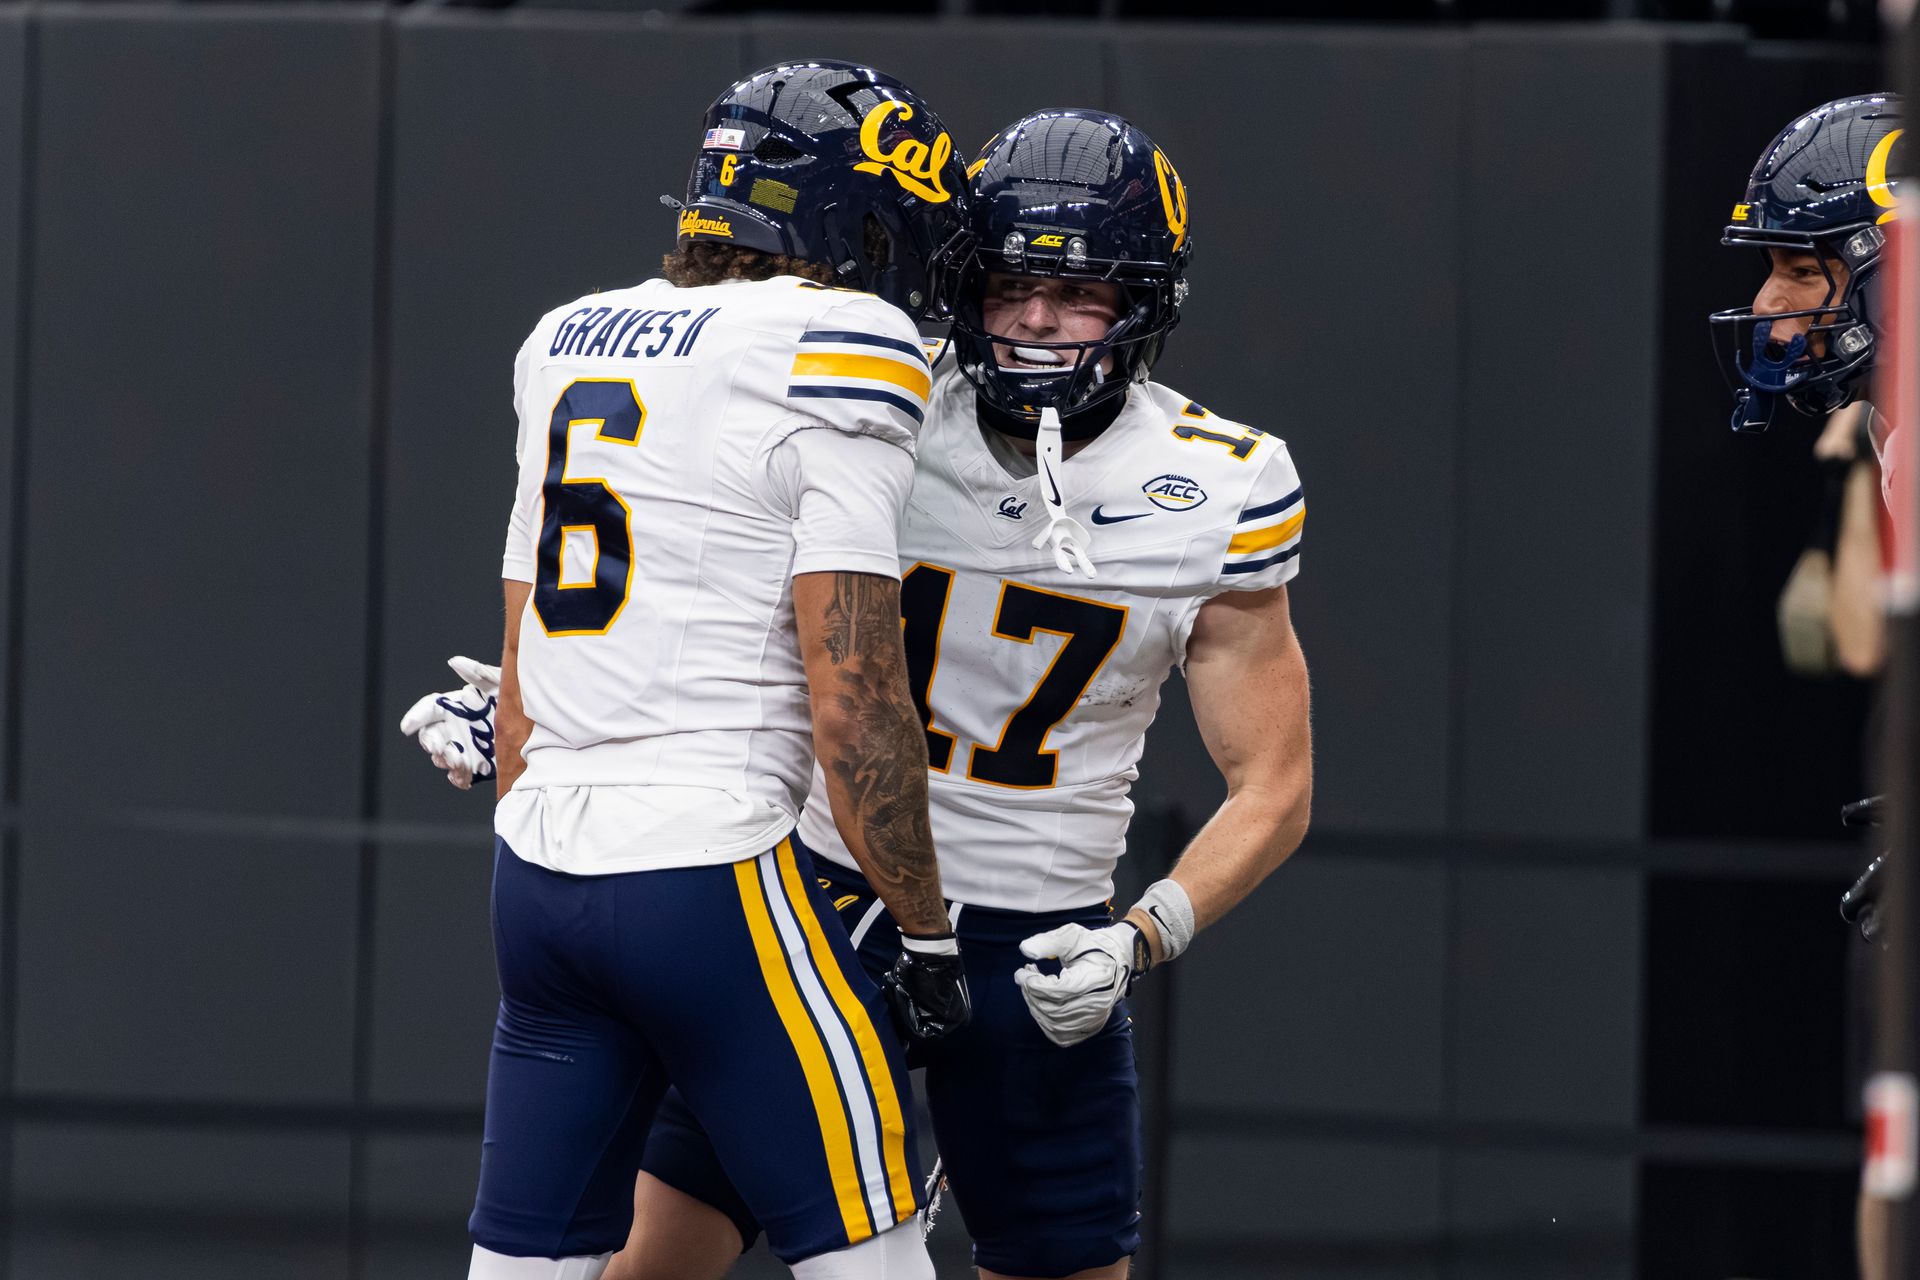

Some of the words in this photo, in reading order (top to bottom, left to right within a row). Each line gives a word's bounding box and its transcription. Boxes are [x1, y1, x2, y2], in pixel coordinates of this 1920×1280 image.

[720, 154, 737, 187] 6
[853, 100, 951, 203] Cal
[679, 209, 733, 238] California
[1030, 234, 1066, 247] ACC
[549, 306, 692, 358] GRAYES
[673, 306, 722, 357] II
[1171, 400, 1266, 462] 1
[532, 377, 648, 638] 6
[996, 496, 1028, 519] Cal
[1150, 483, 1200, 502] ACC
[900, 561, 1130, 791] 17
